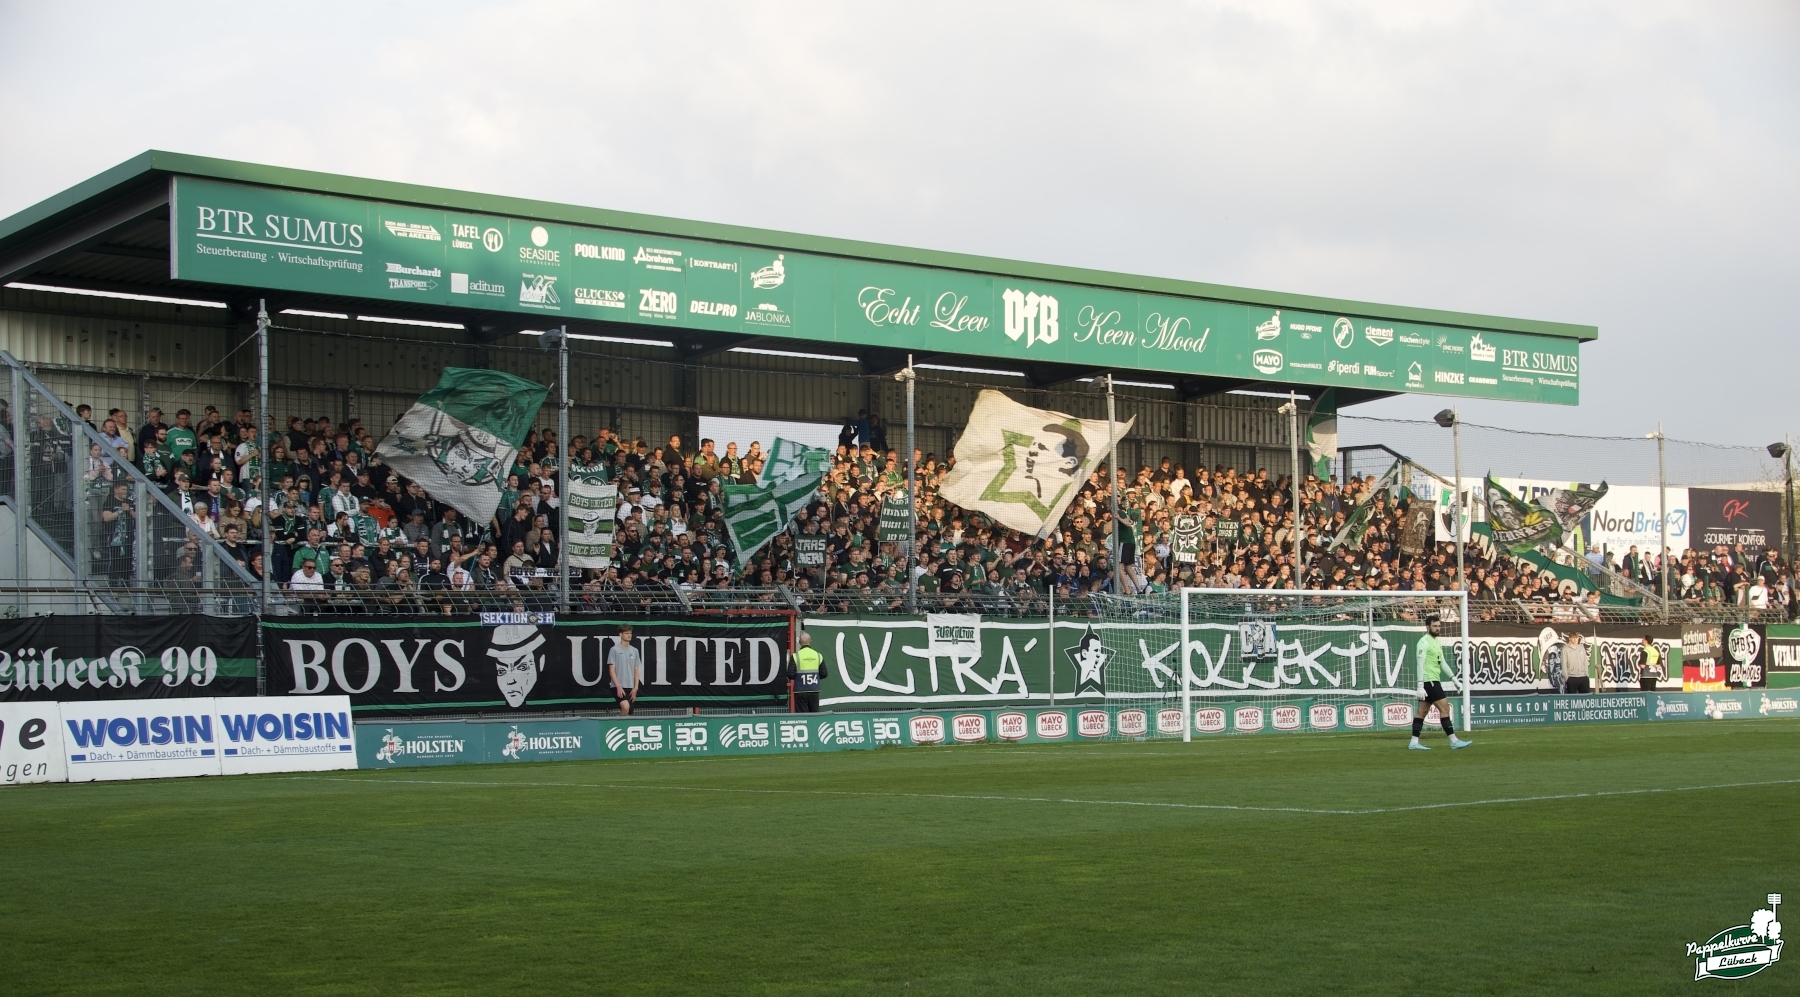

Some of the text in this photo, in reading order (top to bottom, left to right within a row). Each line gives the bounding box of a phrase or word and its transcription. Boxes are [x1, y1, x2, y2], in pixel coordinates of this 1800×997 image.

[197, 206, 363, 248] BTR SUMUS
[452, 224, 480, 240] TAFEL
[452, 239, 473, 250] LÜBECK
[196, 242, 363, 272] Steuerberatung Wirtschaftsprüfung
[520, 247, 560, 262] SEASIDE
[633, 246, 674, 264] Abraham
[395, 263, 442, 278] Burchardt
[470, 280, 505, 293] aditum
[690, 300, 737, 317] DELLPRO
[858, 286, 990, 333] Echt Leev
[744, 311, 790, 324] JABLONKA
[1074, 304, 1210, 354] Keen Mood
[1365, 326, 1394, 337] clement
[1400, 335, 1430, 346] Küchenstyle
[1256, 354, 1280, 366] MAYO
[1502, 349, 1529, 368] BTR
[1532, 352, 1577, 372] SUMUS
[1336, 361, 1360, 375] iperdi
[1434, 371, 1464, 384] HINZKE
[1469, 376, 1498, 385] GRABOWSKI
[1502, 374, 1577, 389] Steuerberatung Wirtschaftsprüfung
[571, 494, 613, 508] BOYS UNITED
[1722, 499, 1750, 522] GK
[1706, 532, 1738, 545] GOURMET
[590, 546, 606, 555] 2002
[483, 612, 528, 624] SEKTION
[161, 646, 217, 687] 99
[283, 638, 466, 694] BOYS
[801, 674, 818, 685] 154
[1553, 697, 1645, 710] IHRE IMMOBILIENEXPERTEN
[1666, 703, 1688, 712] HOLSTEN
[1716, 702, 1742, 711] HOLSTEN
[1772, 700, 1798, 710] HOLSTEN
[1239, 711, 1259, 719] MAYO
[1276, 709, 1296, 718] MAYO
[1314, 708, 1333, 716] MAYO
[1350, 708, 1368, 716] MAYO
[1388, 707, 1408, 715] MAYO
[1554, 708, 1638, 721] IN DER LÜBECKER BUCHT.
[915, 720, 938, 729] MAYO
[958, 718, 980, 727] MAYO
[1002, 717, 1022, 725] MAYO
[1041, 716, 1062, 724] MAYO
[1122, 714, 1142, 722] MAYO
[66, 714, 214, 748] WOISIN
[220, 712, 350, 744] WOISIN
[780, 725, 808, 743] 30
[874, 722, 900, 740] 30
[530, 736, 581, 750] HOLSTEN
[675, 727, 707, 746] 30
[241, 745, 264, 755] Dach-
[273, 743, 337, 755] Dämmbaustoffe
[406, 740, 464, 754] HOLSTEN
[627, 743, 663, 751] GROUP
[738, 740, 769, 748] GROUP
[90, 750, 116, 762] Dach-
[127, 748, 198, 760] Dämmbaustoffe
